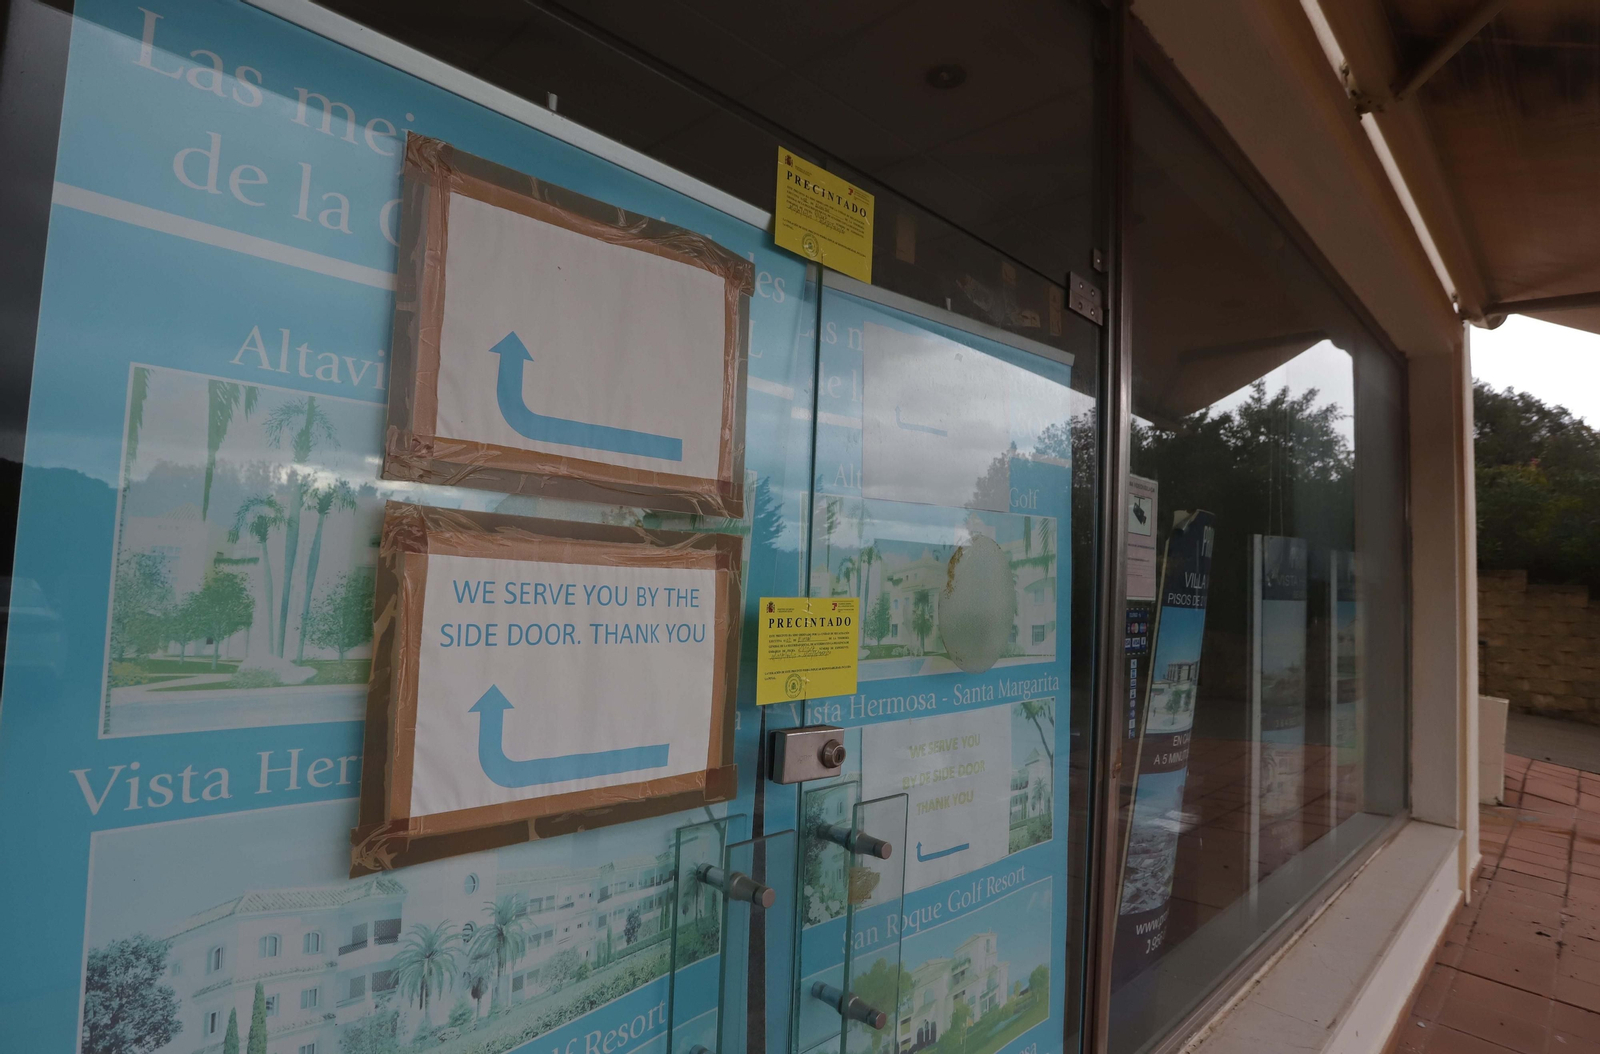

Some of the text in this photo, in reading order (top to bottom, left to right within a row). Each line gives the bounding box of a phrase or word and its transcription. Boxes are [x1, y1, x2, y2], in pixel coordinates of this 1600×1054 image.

[132, 6, 263, 108] Las
[172, 132, 269, 208] de
[292, 161, 353, 235] la
[786, 170, 867, 218] PRECINTADO
[229, 325, 386, 391] Altavi
[1009, 487, 1040, 510] Golf
[453, 580, 700, 608] WE SERVE YOU BY THE
[1167, 592, 1192, 606] PISOS
[440, 623, 706, 648] SIDE DOOR. THANK YOU
[768, 616, 852, 629] PRECINTADO
[789, 700, 842, 727] Vista
[849, 692, 936, 719] Hermosa
[953, 683, 994, 706] Santa
[998, 672, 1060, 700] Margarita
[909, 733, 980, 759] WE SERVE YOU
[1162, 753, 1168, 765] 5
[68, 748, 363, 816] Vista Her
[902, 774, 917, 790] BY
[933, 766, 955, 782] SIDE
[958, 760, 986, 777] DOOR
[916, 790, 974, 815] THANK YOU
[886, 902, 942, 938] Roque
[947, 877, 984, 912] Golf
[986, 864, 1026, 898] Resort
[583, 999, 666, 1054] Resort
